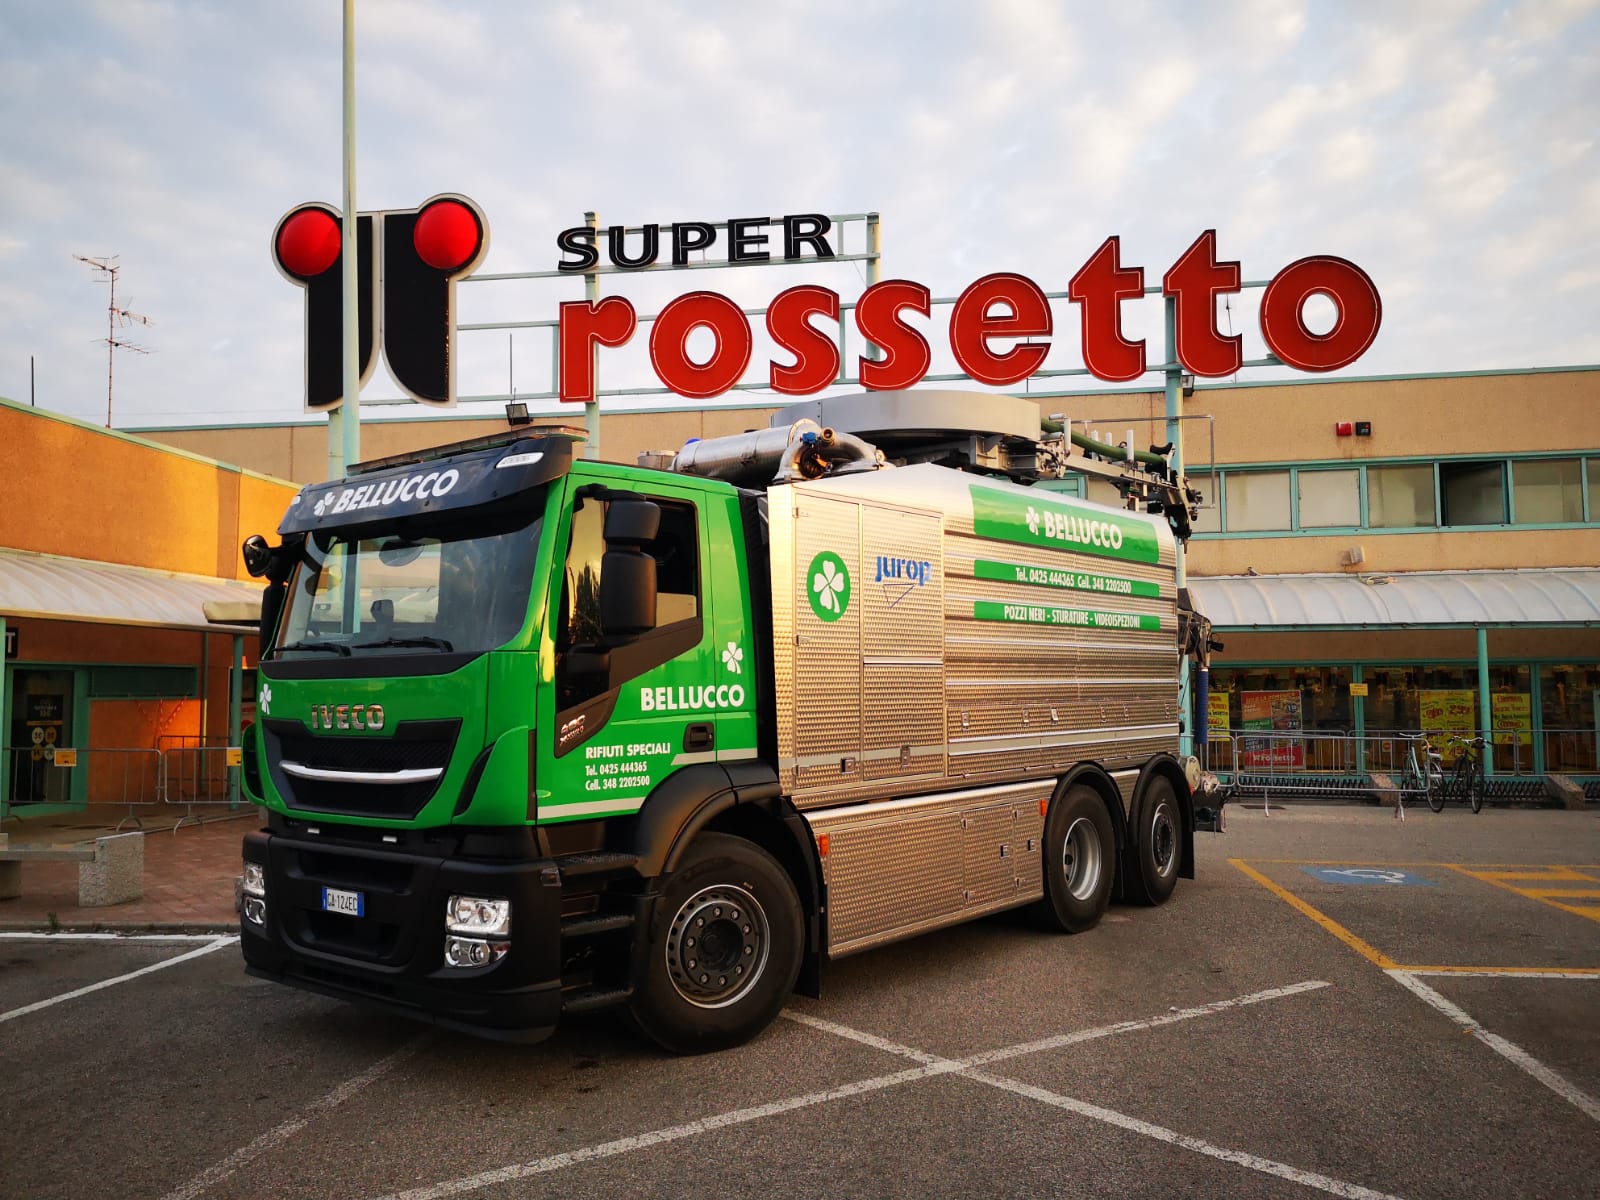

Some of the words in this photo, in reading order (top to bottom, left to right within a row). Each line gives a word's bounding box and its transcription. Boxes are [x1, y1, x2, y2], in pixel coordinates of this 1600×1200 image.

[556, 213, 838, 272] SUPER
[559, 228, 1382, 404] rossetto
[331, 469, 460, 515] BELLUCCO
[1044, 510, 1123, 550] BELLUCCO
[1015, 567, 1028, 581] Tel.
[1029, 569, 1047, 584] 0425
[1049, 571, 1075, 587] 444365
[1077, 575, 1091, 589] Cell.
[1092, 577, 1104, 590] 348
[1105, 580, 1131, 593] 2202500
[1004, 605, 1027, 620] POZZI
[1028, 607, 1045, 622] NERI
[1051, 610, 1088, 625] STURATURE
[1094, 613, 1140, 628] VIDEOISPEZIONI
[640, 683, 745, 712] BELLUCCO
[310, 703, 386, 731] IVECO
[585, 745, 624, 759] RIFIUTI
[626, 742, 671, 756] SPECIALI
[585, 765, 598, 776] Tel.
[599, 763, 618, 775] 0425
[620, 761, 647, 774] 444365
[585, 780, 601, 791] Cell.
[602, 777, 617, 789] 348
[618, 775, 650, 788] 2202500
